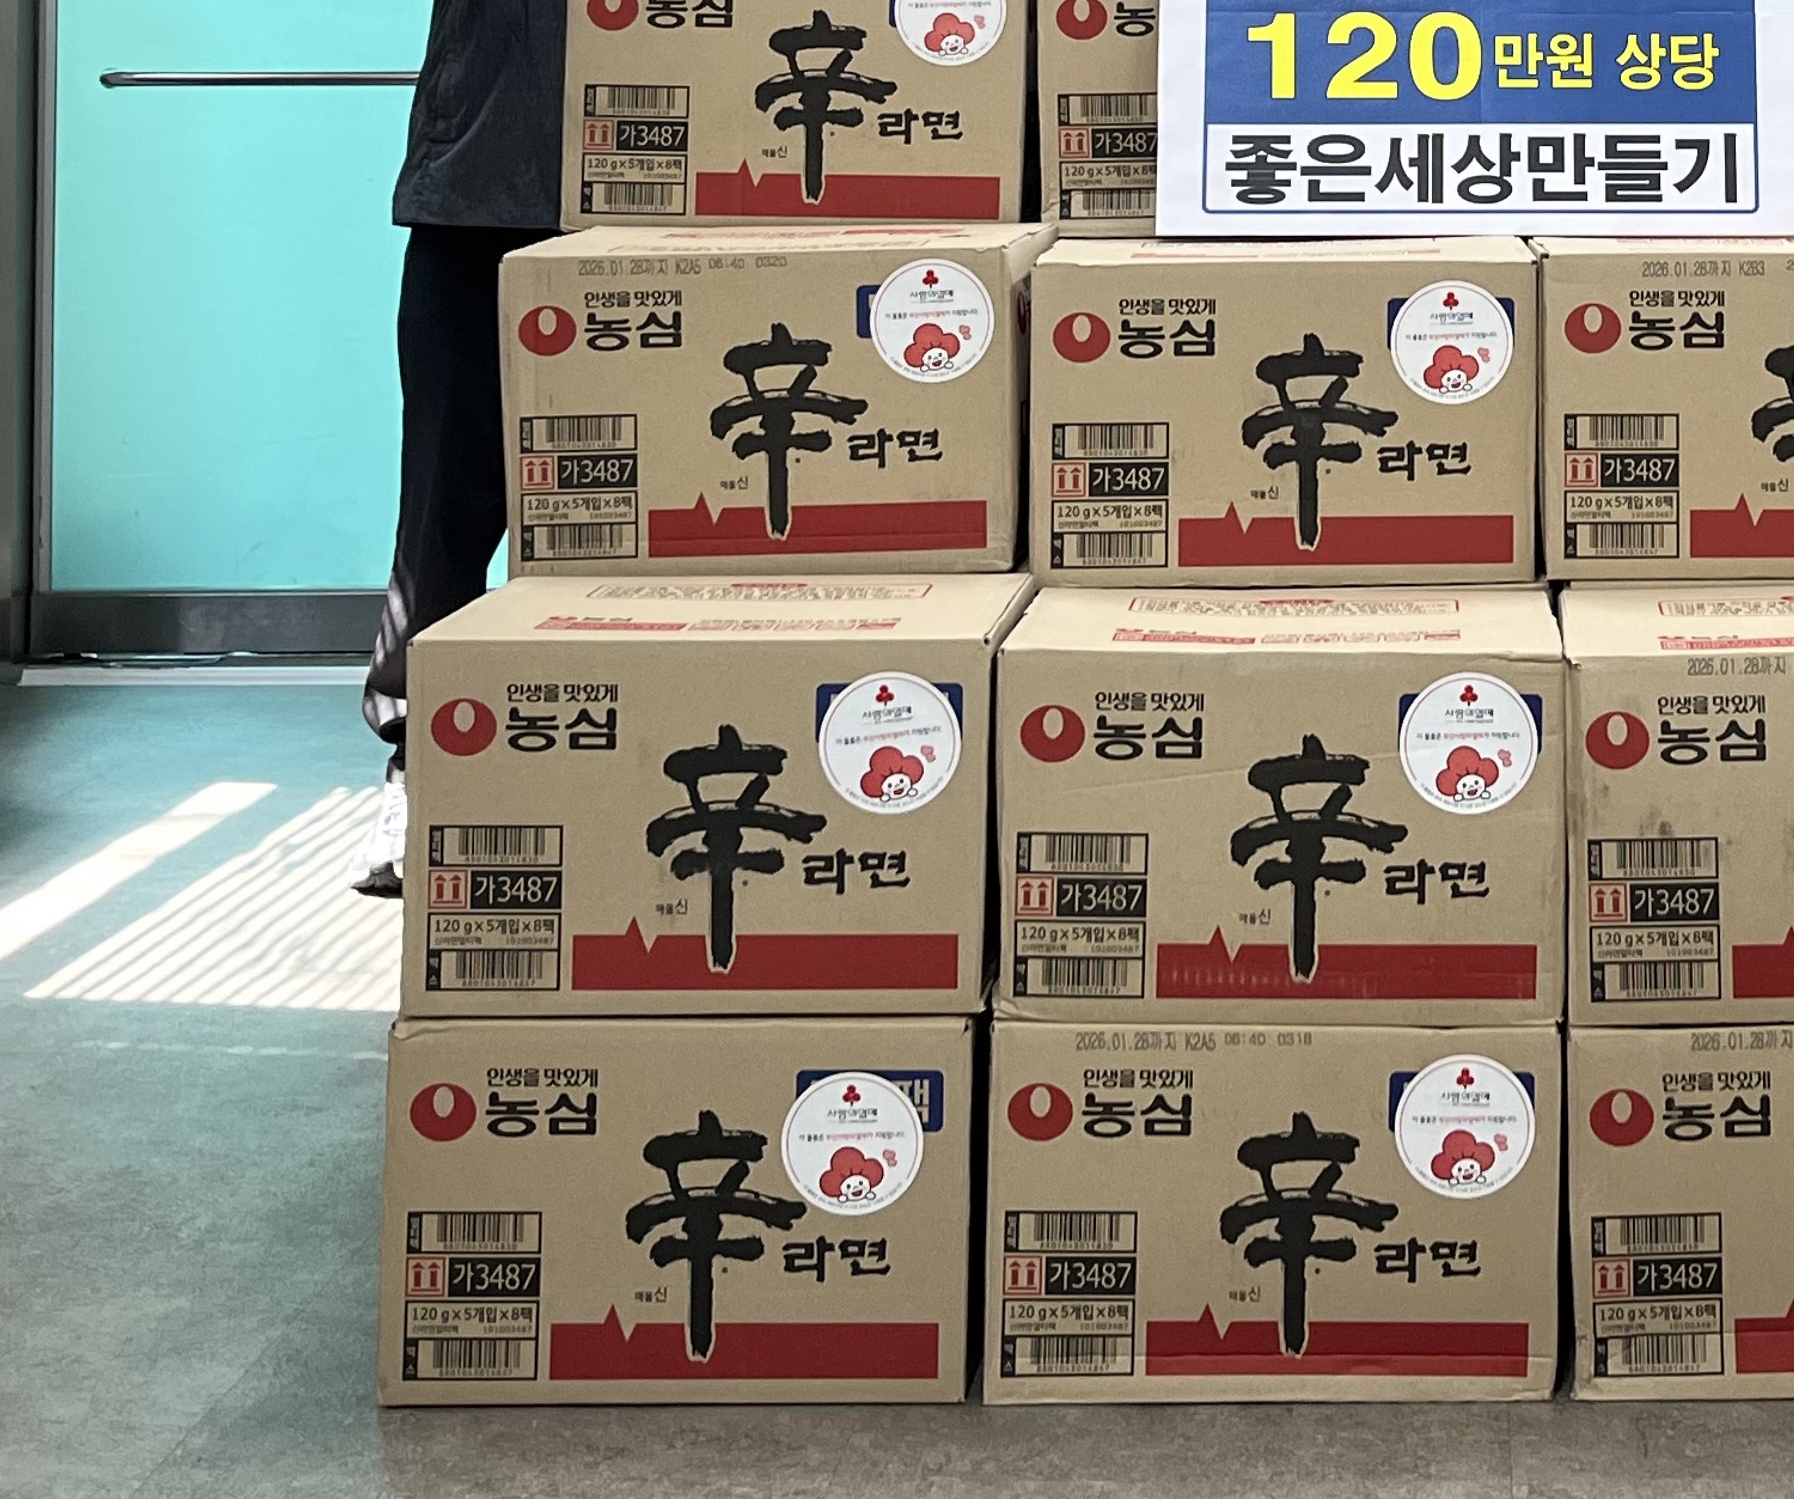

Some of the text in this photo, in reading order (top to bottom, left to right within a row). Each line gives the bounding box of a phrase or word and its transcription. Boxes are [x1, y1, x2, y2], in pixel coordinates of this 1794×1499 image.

[1114, 3, 1156, 37] 농
[1247, 10, 1720, 101] 120만원 상당
[755, 10, 897, 202] 辛
[619, 126, 685, 147] 가3487
[878, 109, 963, 144] 라면
[1094, 133, 1158, 155] 가3487
[1225, 132, 1738, 206] 좋은세상만들기
[584, 291, 682, 306] 인생을 맛있게
[1118, 298, 1216, 315] 인생을 맛있게
[1629, 291, 1725, 306] 인생을 맛있게
[584, 311, 682, 351] 농심
[1118, 320, 1216, 359] 농심
[1628, 311, 1725, 350] 농심
[710, 322, 868, 538] 辛
[848, 428, 944, 468] 라면
[1242, 334, 1398, 549] 辛
[561, 458, 633, 483] 가3487
[1093, 468, 1164, 492] 가3487
[1377, 441, 1472, 481] 라면
[1604, 458, 1675, 482] 가3487
[507, 684, 618, 702] 인생을 맛있게
[1095, 693, 1204, 711] 인생을 맛있게
[1658, 696, 1766, 714] 인생을 맛있게
[505, 707, 618, 752] 농심
[1094, 716, 1203, 761] 농심
[1658, 719, 1767, 765] 농심
[647, 724, 827, 972] 辛
[1231, 734, 1408, 979] 辛
[474, 874, 558, 903] 가3487
[803, 849, 910, 894] 라면
[1384, 858, 1489, 904] 라면
[1060, 883, 1143, 912] 가3487
[1634, 887, 1714, 915] 가3487
[487, 1068, 598, 1087] 인생을 맛있게
[1083, 1070, 1193, 1088] 인생을 맛있게
[1662, 1072, 1771, 1091] 인생을 맛있게
[485, 1092, 598, 1138] 농심
[1082, 1093, 1193, 1139] 농심
[1662, 1097, 1771, 1141] 농심
[625, 1110, 807, 1360] 辛
[1220, 1112, 1398, 1355] 辛
[452, 1262, 536, 1291] 가3487
[782, 1237, 891, 1281] 라면
[1049, 1263, 1131, 1291] 가3487
[1374, 1239, 1481, 1283] 라면
[1637, 1263, 1718, 1292] 가3487
